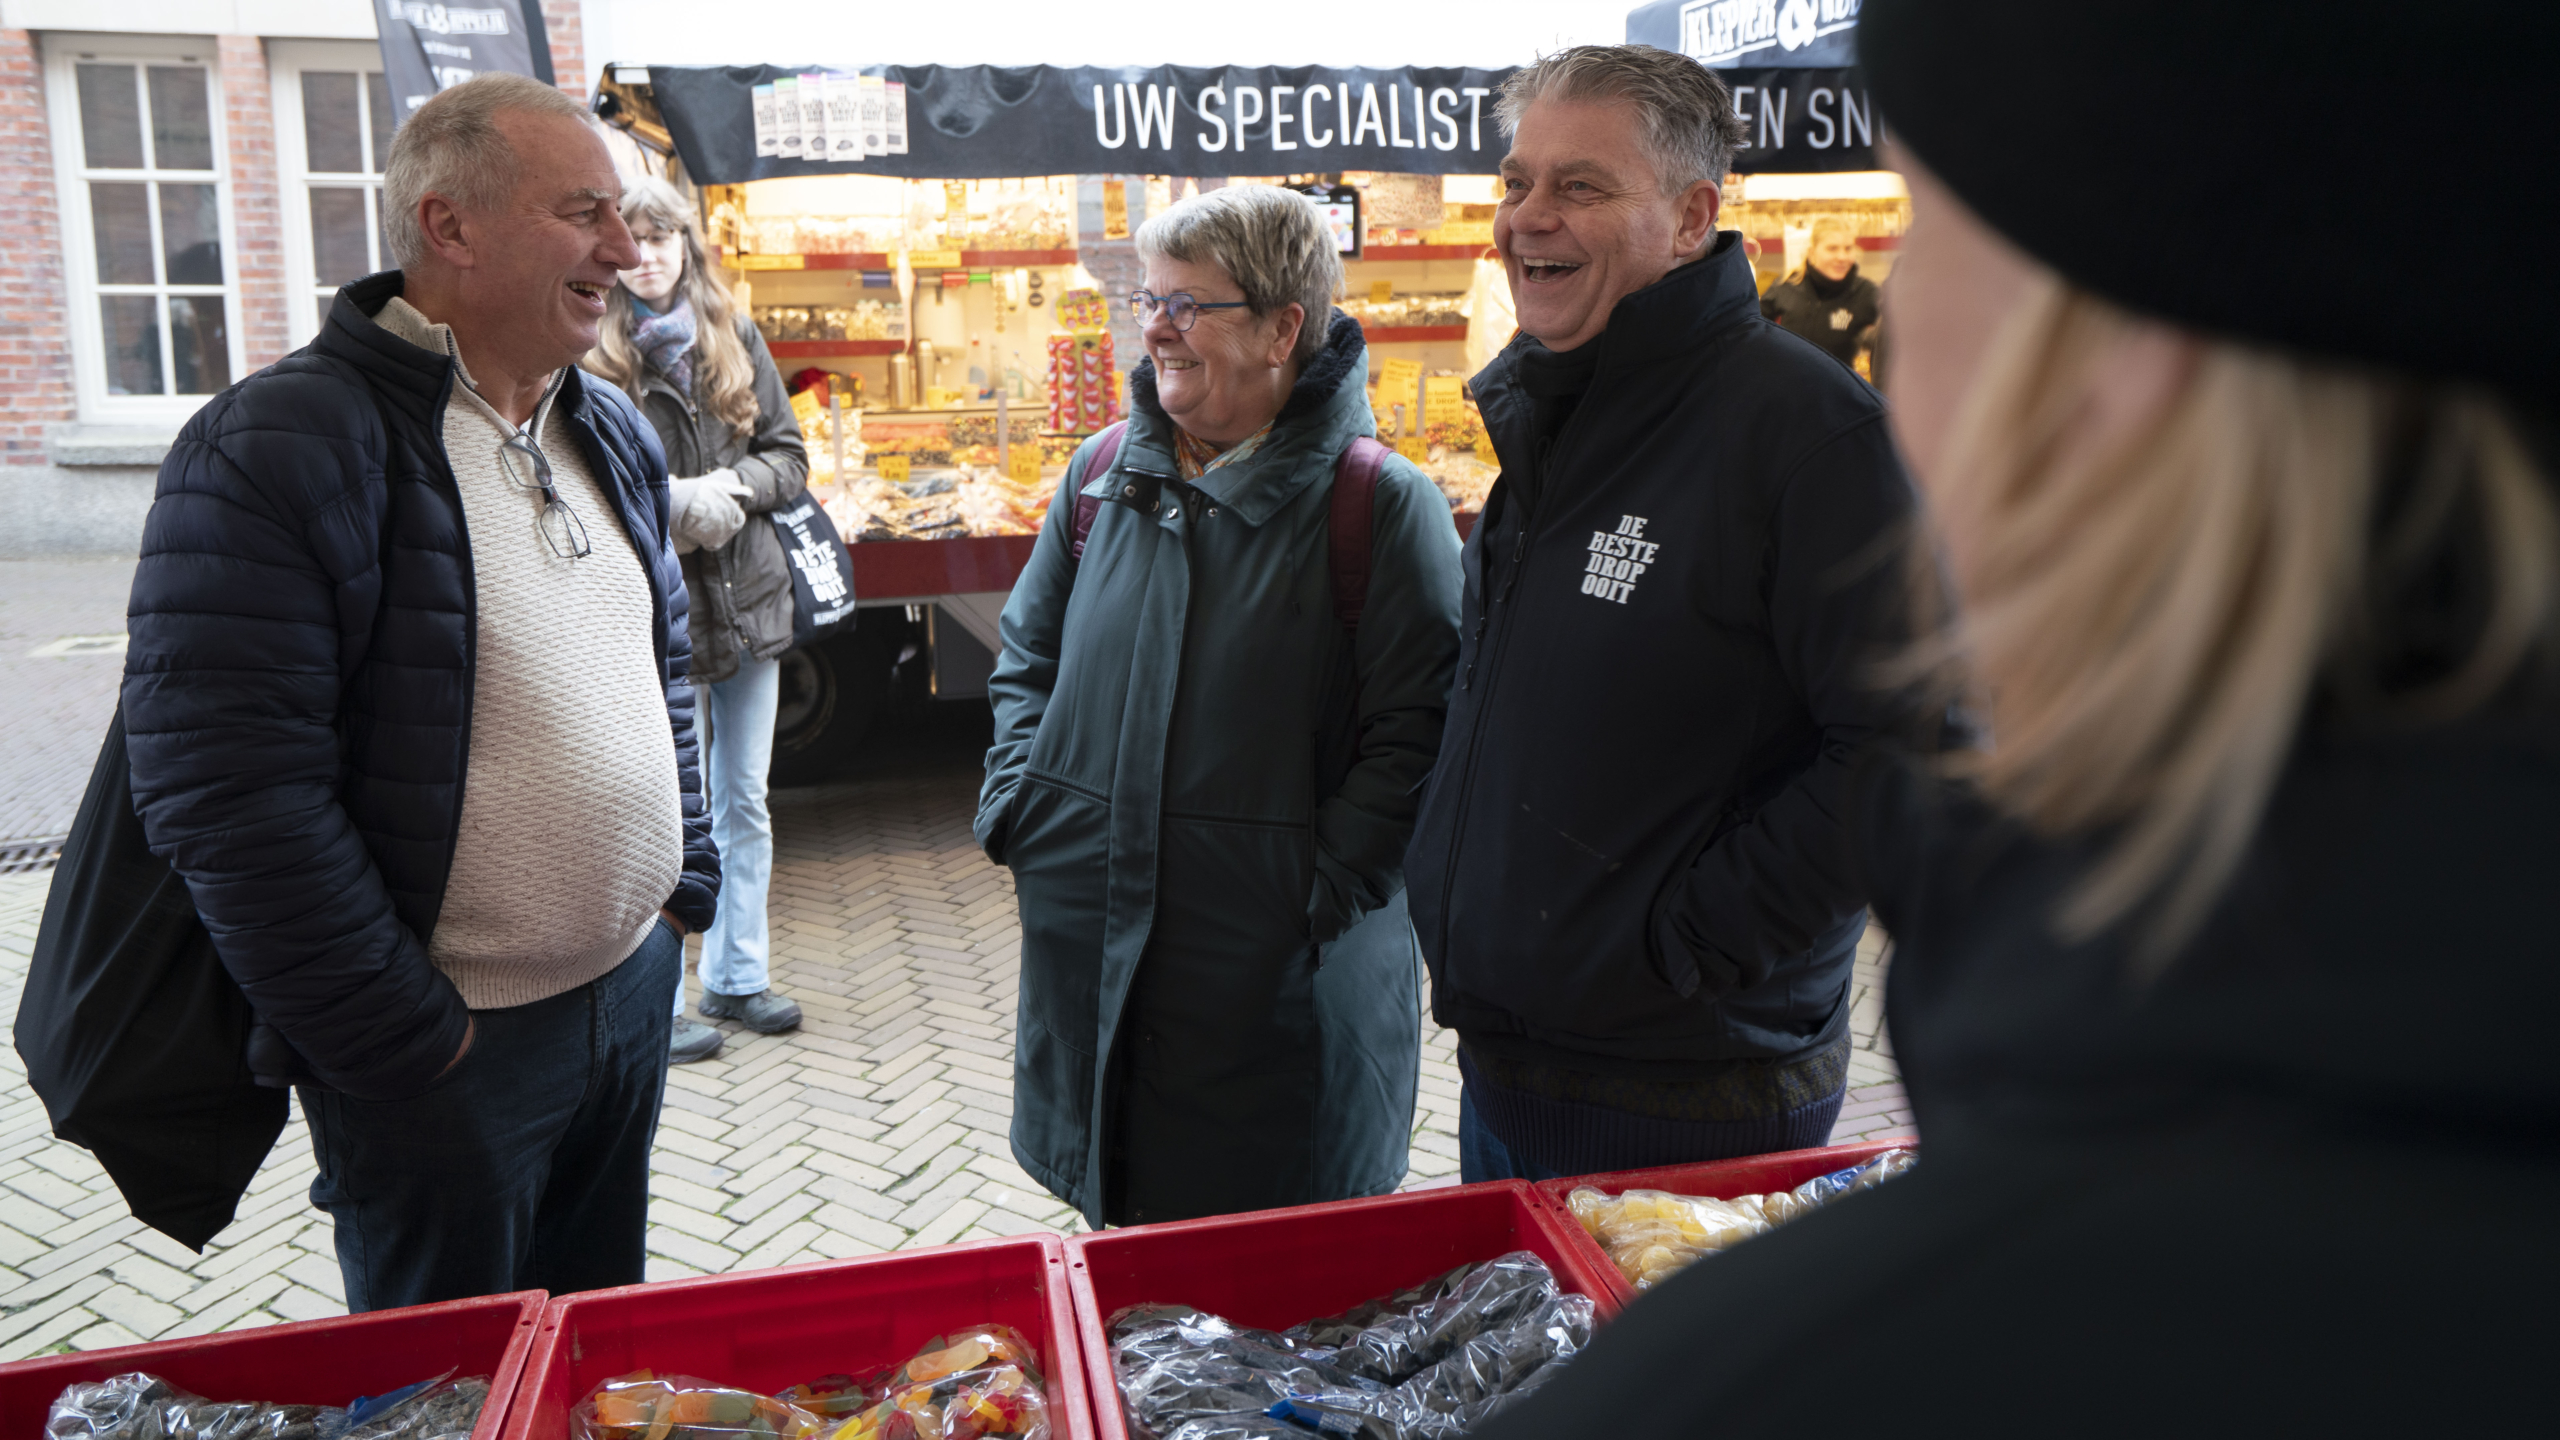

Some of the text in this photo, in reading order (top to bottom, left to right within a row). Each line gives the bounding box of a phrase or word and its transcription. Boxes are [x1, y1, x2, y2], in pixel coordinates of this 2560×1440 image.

[1093, 82, 1889, 153] UW SPECIALIST EN SN
[1615, 514, 1649, 539] DE
[1587, 531, 1660, 564] BESTE
[1584, 552, 1646, 584] DROP
[1580, 573, 1636, 605] OOIT
